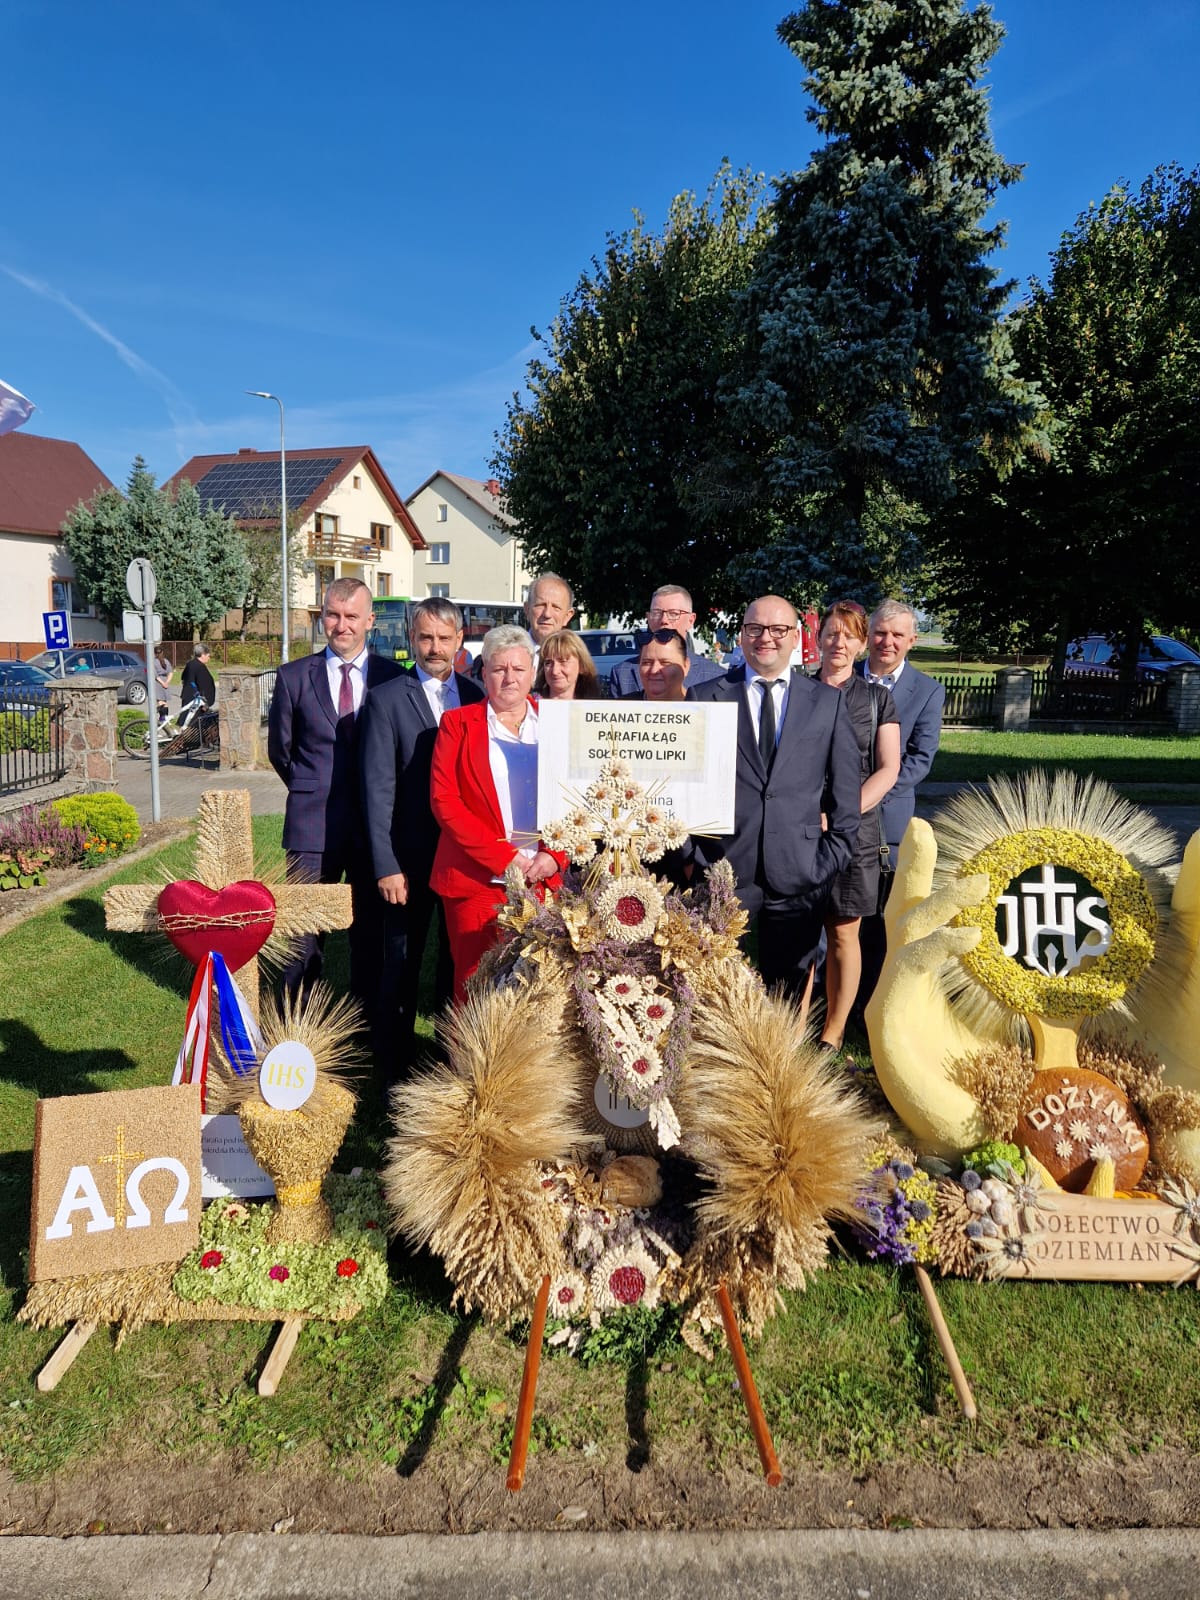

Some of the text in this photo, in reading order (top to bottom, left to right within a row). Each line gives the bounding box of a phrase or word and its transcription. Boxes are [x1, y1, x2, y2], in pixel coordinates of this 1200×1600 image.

[48, 615, 63, 639] P
[585, 712, 691, 724] DEKANAT CZERSK
[598, 731, 677, 744] PARAFIA ŁĄG
[656, 750, 686, 760] LIPKI
[267, 1063, 307, 1089] IHS
[1026, 1078, 1147, 1153] DOŻYNKI
[126, 1157, 190, 1229] Ω
[1036, 1240, 1177, 1262] DZIEMIANY
